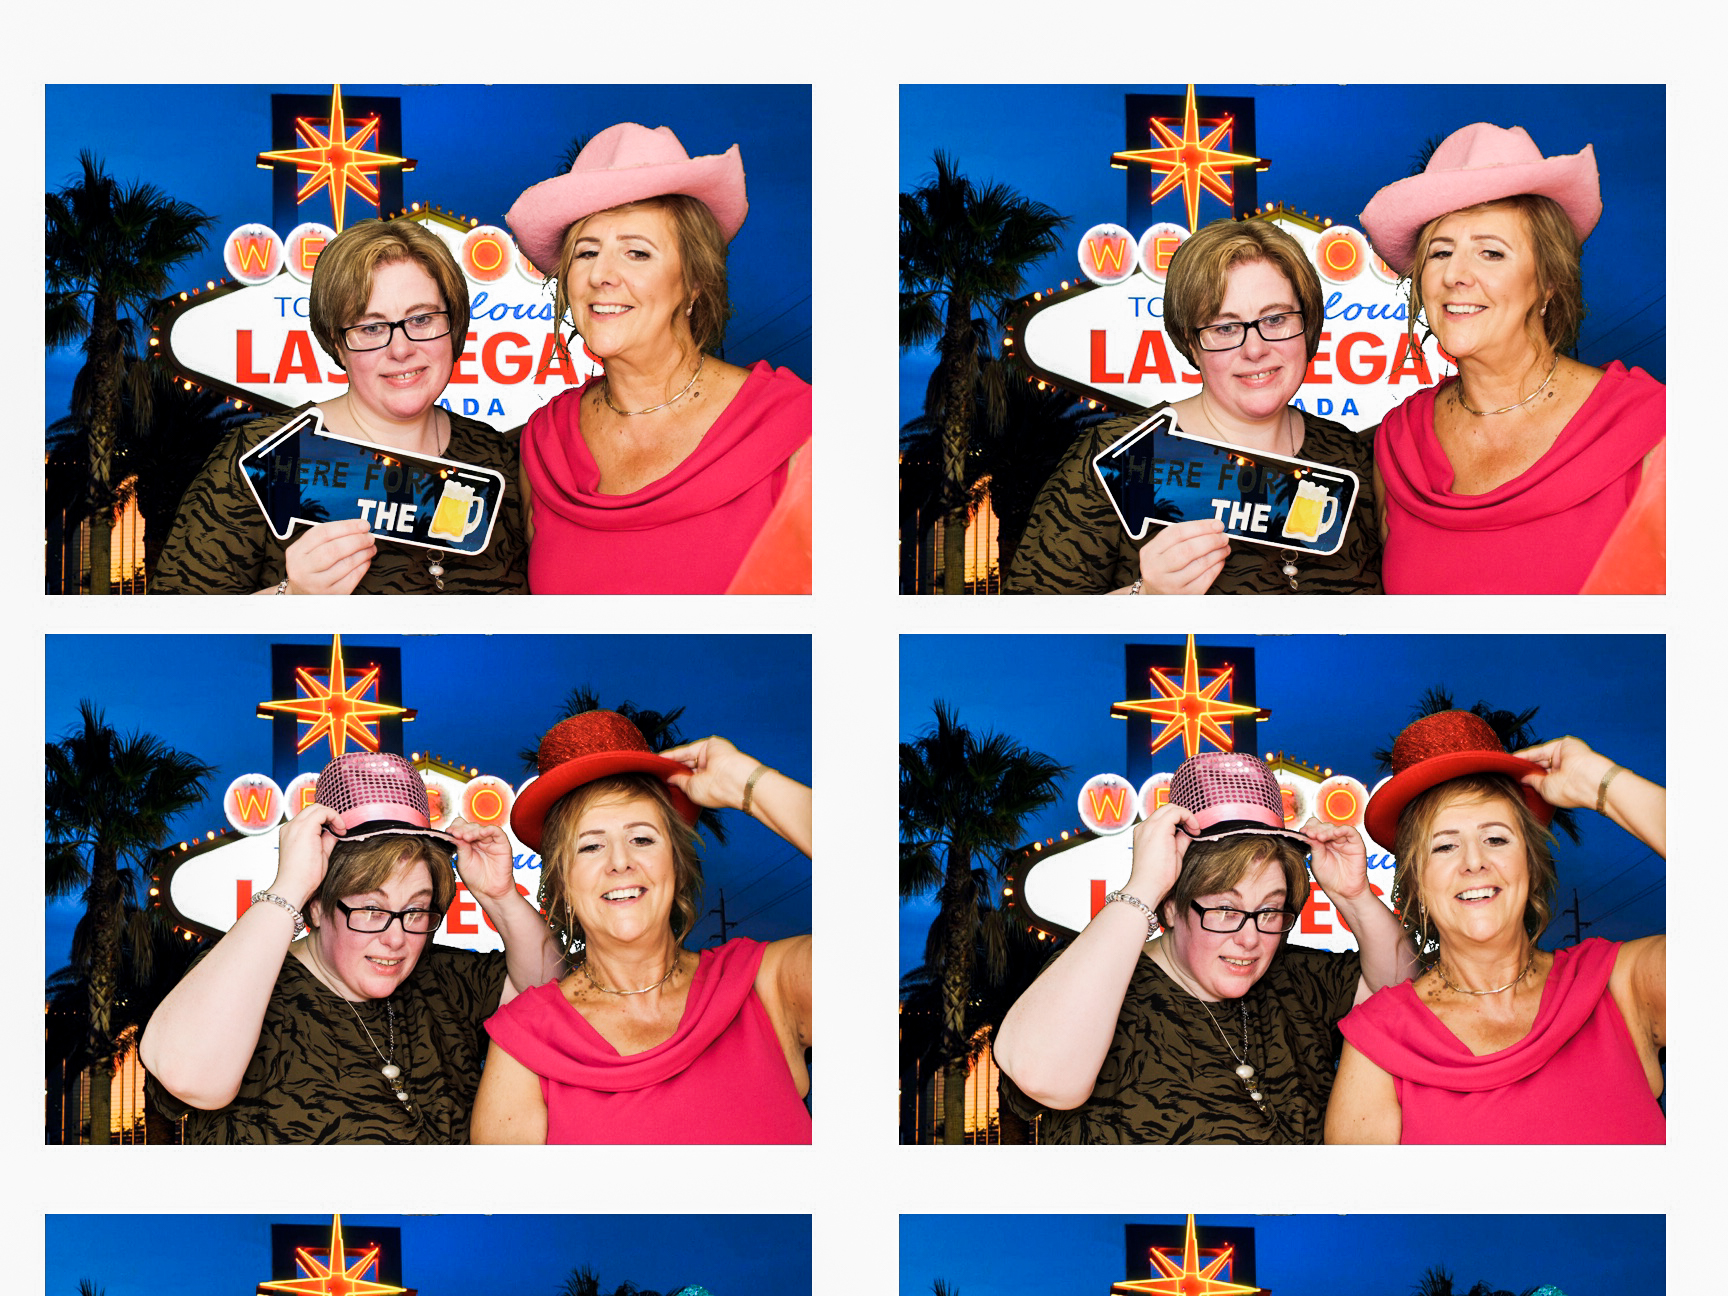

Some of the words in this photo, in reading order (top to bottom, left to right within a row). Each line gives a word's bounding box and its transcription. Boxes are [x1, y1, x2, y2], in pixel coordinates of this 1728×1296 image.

[438, 398, 506, 416] ADA
[1292, 398, 1360, 416] ADA
[273, 454, 350, 489] HERE
[363, 463, 425, 495] FOR
[1127, 454, 1204, 489] HERE
[1217, 463, 1279, 495] FOR
[357, 498, 418, 533] THE
[1211, 498, 1272, 533] THE
